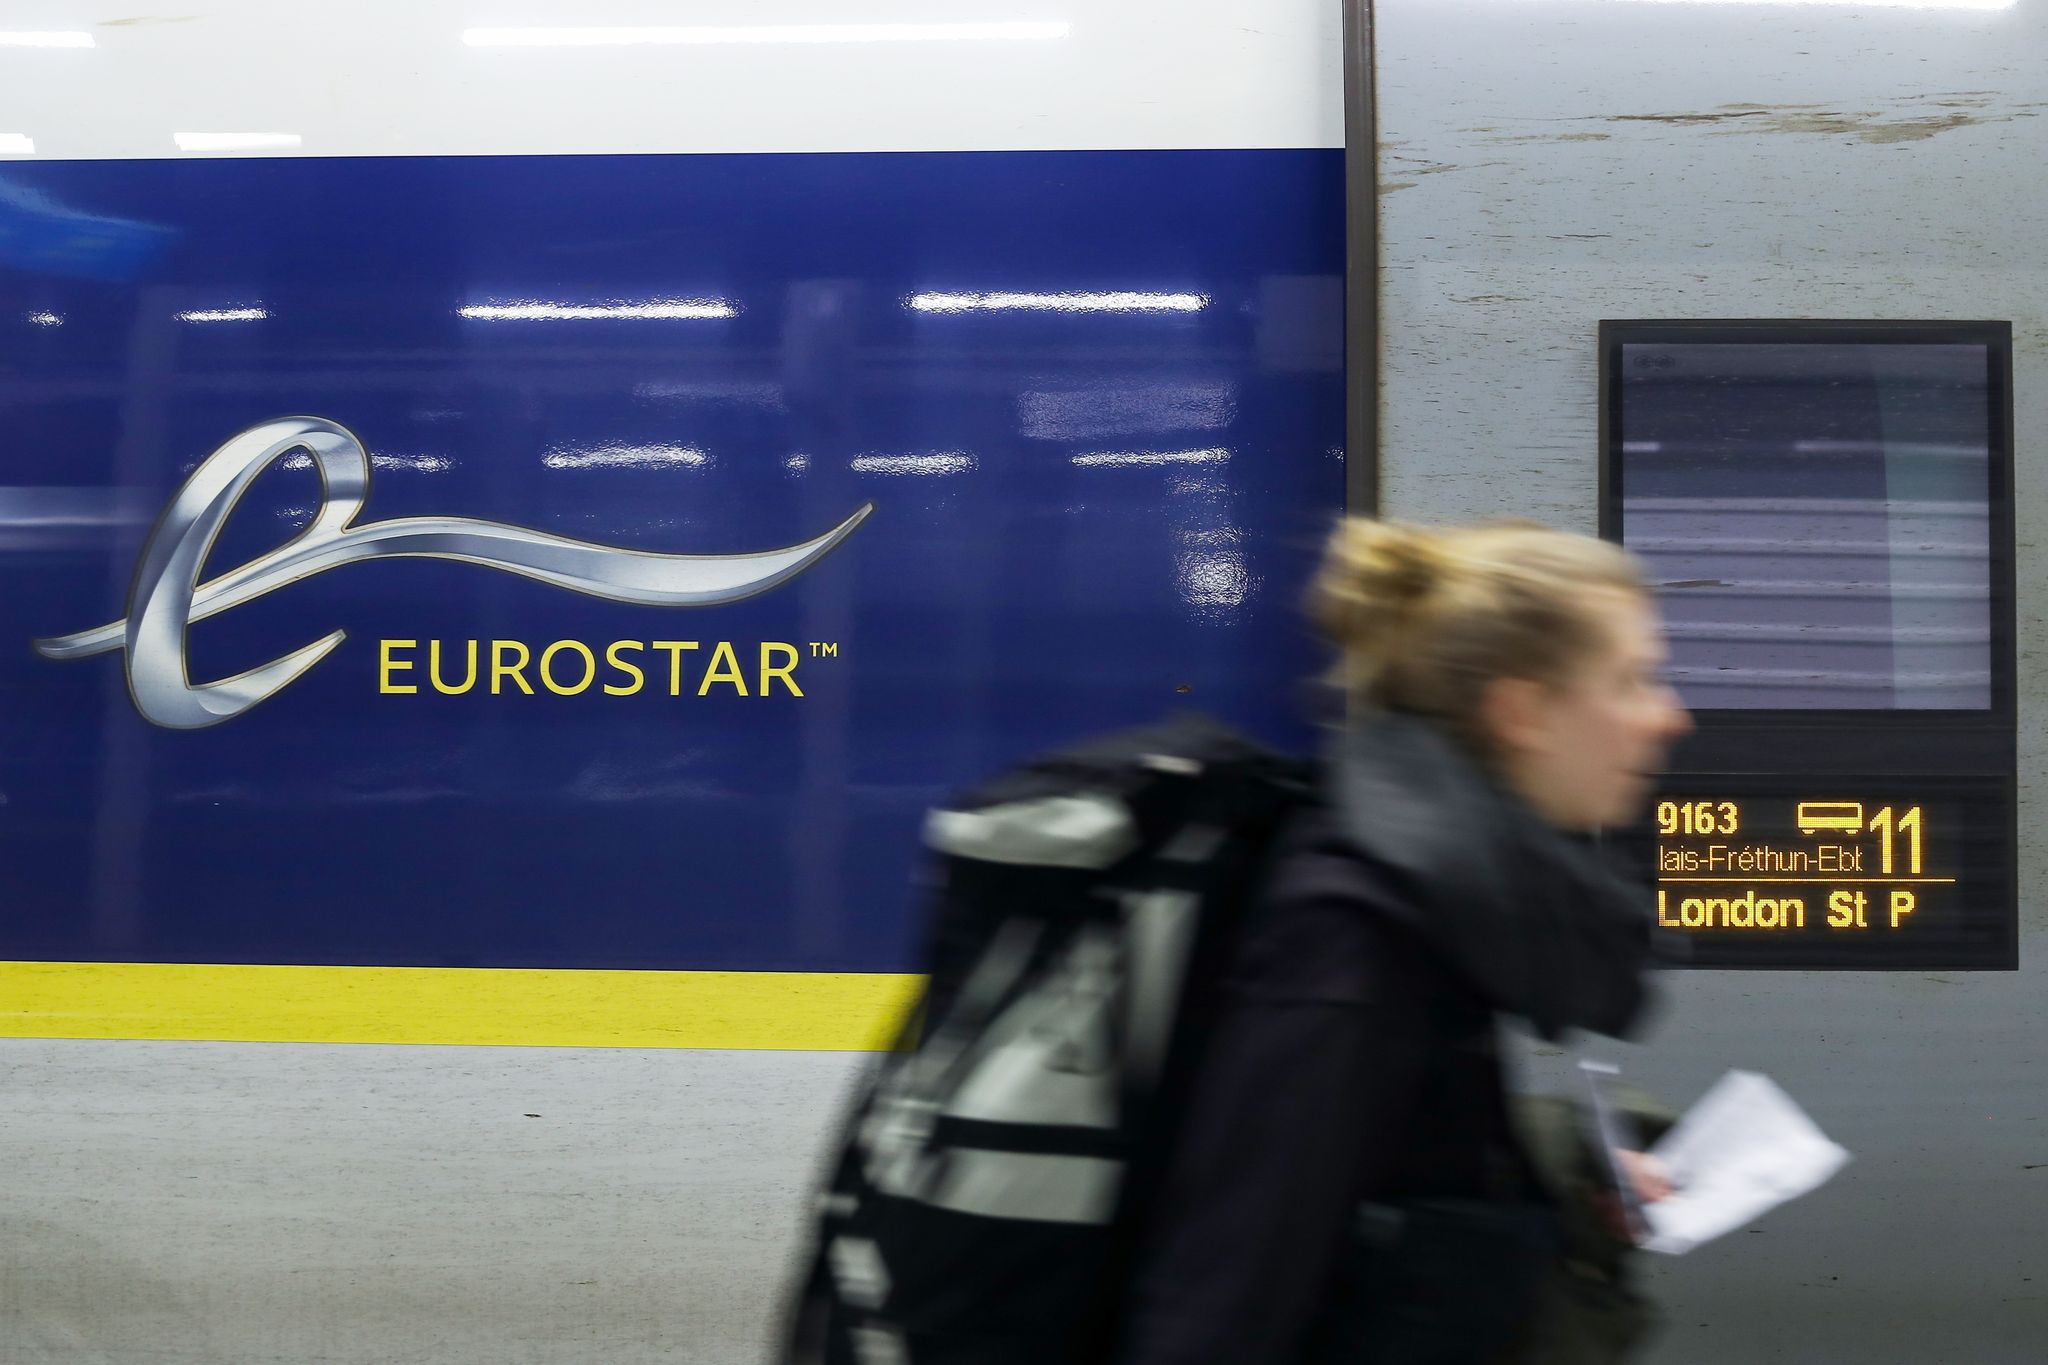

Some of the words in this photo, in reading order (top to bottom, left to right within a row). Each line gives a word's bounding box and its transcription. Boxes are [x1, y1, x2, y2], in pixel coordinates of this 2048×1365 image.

[1656, 801, 1739, 835] 9163
[1868, 805, 1922, 874] 11
[1657, 889, 1805, 929] London
[1826, 889, 1869, 928] St
[1889, 889, 1916, 928] P
